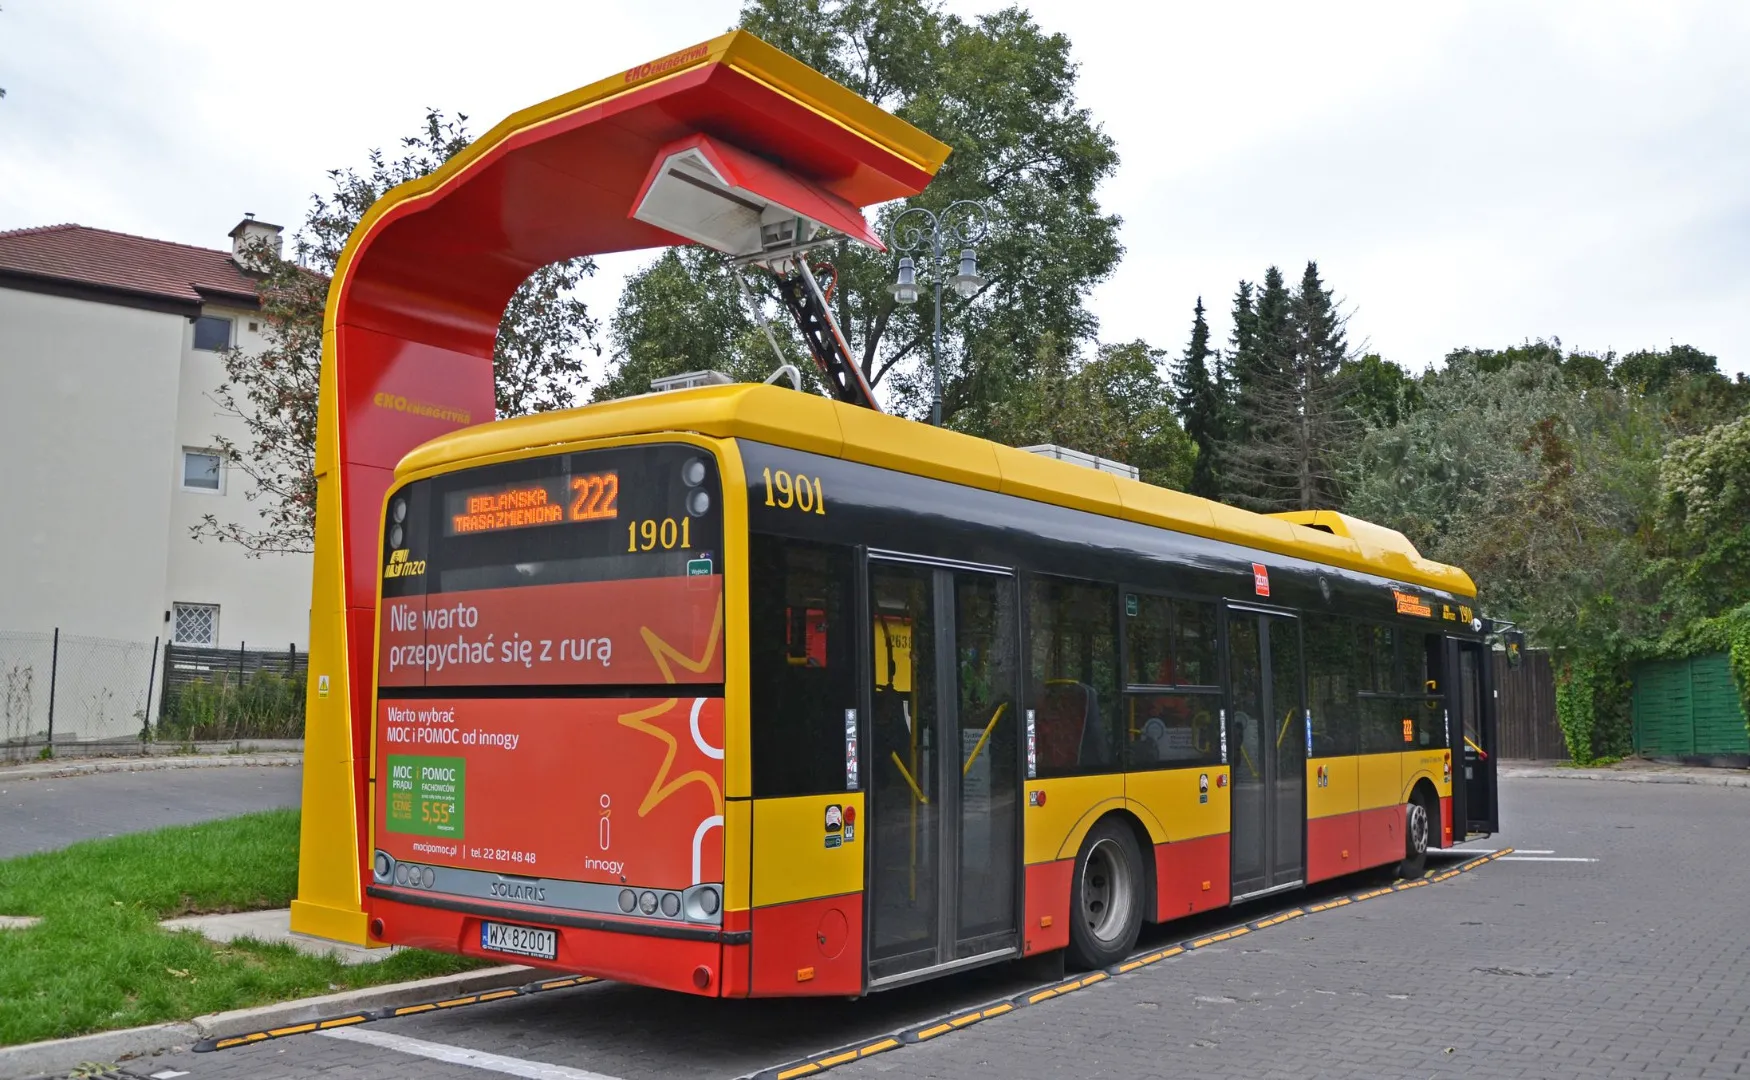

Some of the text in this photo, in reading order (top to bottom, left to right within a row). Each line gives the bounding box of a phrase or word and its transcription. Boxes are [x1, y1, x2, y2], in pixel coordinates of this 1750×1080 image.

[572, 473, 619, 521] 222
[763, 467, 825, 515] 1901
[454, 513, 495, 533] TRASA
[628, 516, 691, 552] 1901
[390, 602, 478, 632] Nie warto
[389, 633, 612, 672] przepychać się z rurą
[387, 706, 455, 726] Warto wybrać
[387, 727, 519, 750] MOC i POMOC od innogy
[393, 765, 413, 779] MOC
[422, 767, 456, 782] POMOC
[422, 801, 449, 824] 5,55
[413, 842, 536, 864] mocipomoc.pl tel. 22 821 48 48
[585, 856, 625, 875] innogy
[490, 882, 546, 901] SOLARIS
[489, 925, 552, 953] WX 82001
